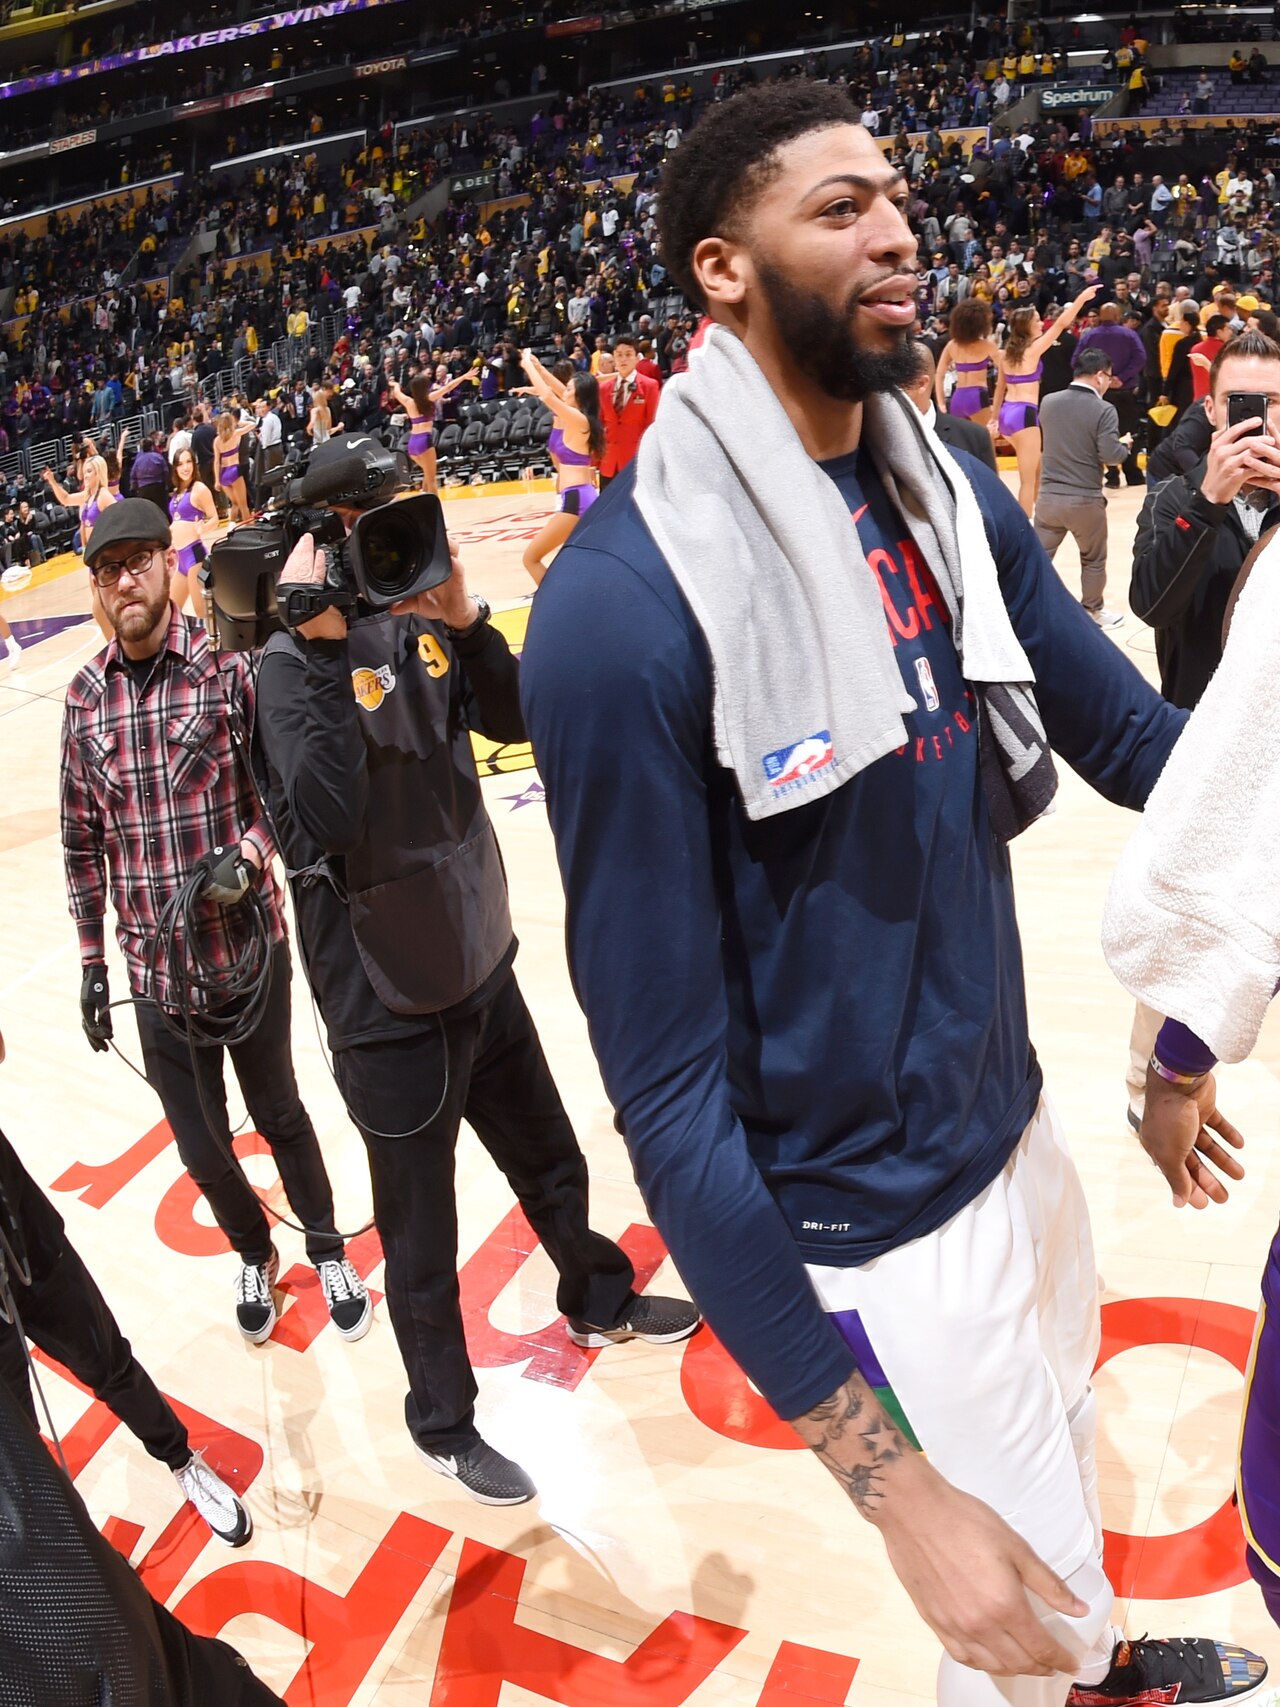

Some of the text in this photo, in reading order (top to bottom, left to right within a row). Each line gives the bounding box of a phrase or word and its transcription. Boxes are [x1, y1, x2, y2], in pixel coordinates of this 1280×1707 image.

[138, 22, 260, 60] LAKERS
[355, 57, 407, 78] TOYOTA
[1042, 90, 1113, 107] Spectrum
[51, 131, 95, 151] STAPLES
[264, 550, 280, 560] SONY
[417, 633, 450, 678] 9
[802, 1220, 851, 1232] DRI-FIT
